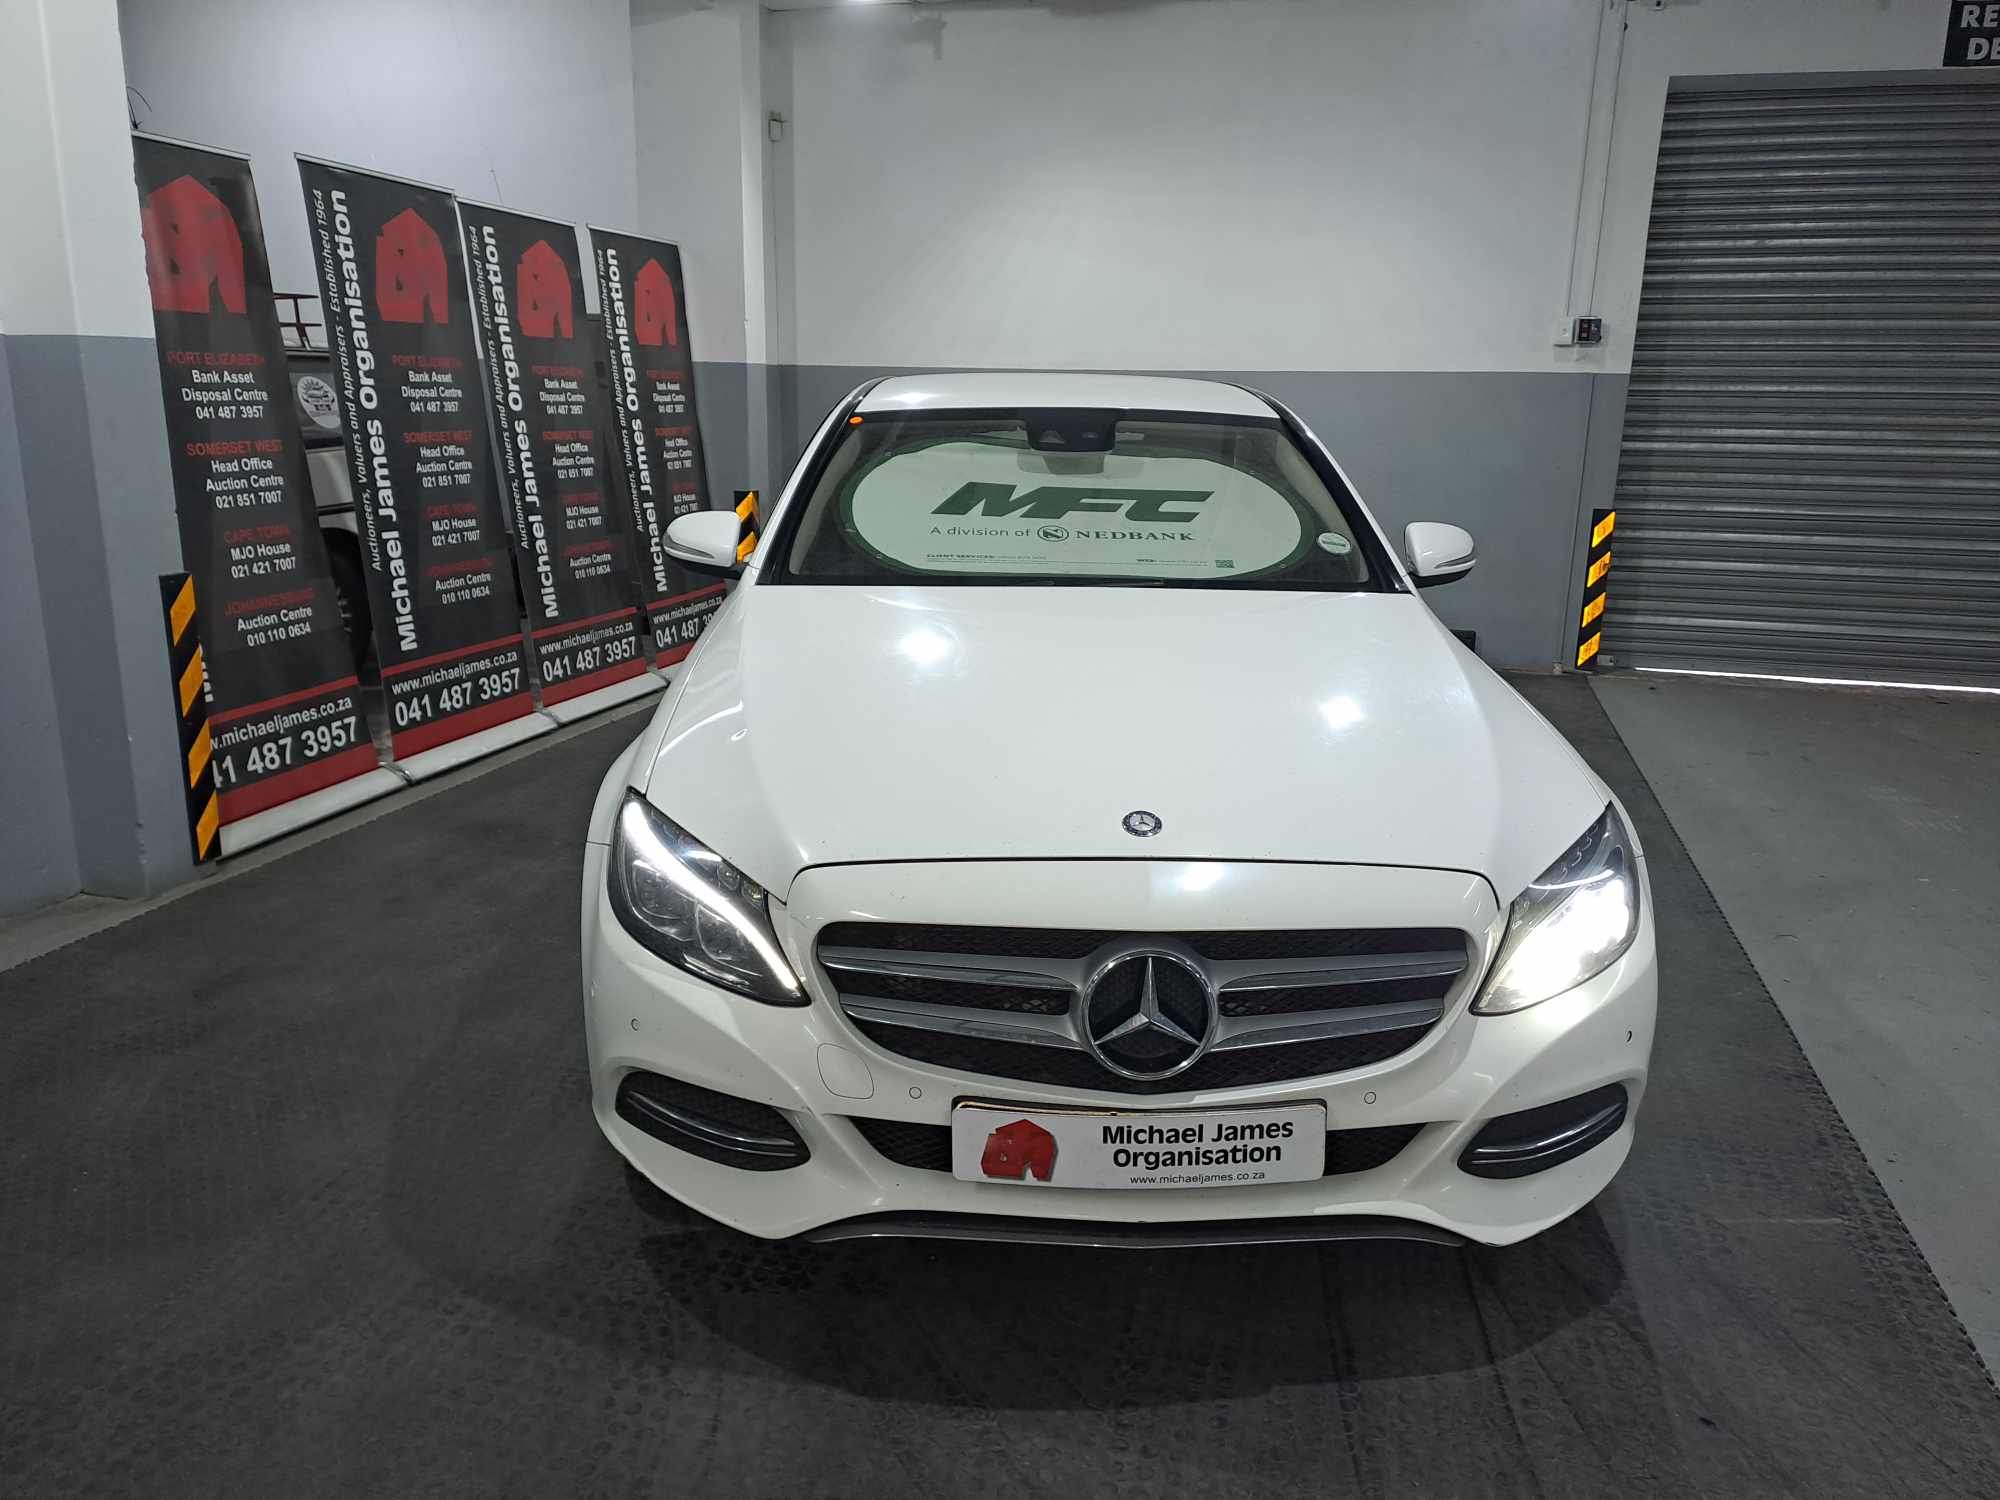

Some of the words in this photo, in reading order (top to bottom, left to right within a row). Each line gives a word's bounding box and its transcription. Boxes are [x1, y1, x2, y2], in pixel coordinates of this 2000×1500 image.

[1960, 5, 2000, 28] RE
[312, 189, 328, 226] 1964
[468, 226, 481, 257] 1964
[317, 229, 342, 313] Established
[330, 190, 379, 410] Organisation
[472, 259, 492, 329] Established
[482, 225, 522, 411] Organisation
[606, 248, 639, 412] Organisation
[335, 325, 355, 399] Appraisers
[487, 340, 504, 403] Appraisers
[192, 369, 221, 383] Bank
[223, 370, 255, 384] Asset
[408, 370, 430, 383] Bank
[431, 371, 453, 383] Asset
[181, 387, 231, 405] Disposal
[234, 388, 268, 401] Centre
[401, 386, 438, 400] Disposal
[439, 387, 463, 399] Centre
[410, 401, 424, 413] 041
[426, 401, 441, 413] 487
[196, 406, 215, 420] 041
[218, 406, 236, 419] 487
[240, 405, 264, 418] 3957
[345, 402, 359, 430] and
[496, 405, 509, 429] and
[616, 405, 626, 426] and
[186, 441, 251, 456] SOMERSET
[352, 432, 368, 483] Valuers
[419, 446, 441, 458] Head
[442, 445, 465, 457] Office
[503, 431, 516, 474] Valuers
[621, 429, 632, 467] Valuers
[632, 419, 652, 495] James
[211, 459, 239, 473] Head
[241, 457, 273, 471] Office
[367, 419, 397, 522] James
[415, 461, 447, 474] Auction
[448, 459, 473, 471] Centre
[515, 420, 540, 507] James
[206, 477, 249, 492] Auction
[250, 474, 284, 488] Centre
[422, 476, 436, 488] 021
[438, 475, 452, 487] 851
[454, 474, 471, 486] 7007
[215, 495, 235, 509] 021
[237, 493, 256, 507] 851
[258, 491, 282, 504] 7007
[511, 479, 529, 549] Auctioneers,
[931, 481, 1215, 523] MFC
[361, 489, 383, 571] Auctioneers,
[432, 520, 450, 532] MJO
[451, 518, 476, 529] House
[432, 535, 446, 546] 021
[447, 532, 461, 544] 421
[463, 530, 480, 542] 7007
[930, 527, 942, 536] A
[947, 527, 1009, 537] division
[1015, 528, 1031, 537] of
[1076, 530, 1196, 541] NEDBANK
[230, 546, 255, 561] MJO
[257, 543, 291, 558] House
[643, 502, 667, 592] Michael
[231, 565, 250, 579] 021
[252, 561, 271, 575] 421
[273, 557, 296, 571] 7007
[528, 515, 559, 618] Michael
[381, 530, 418, 652] Michael
[435, 578, 465, 591] Auction
[466, 572, 491, 585] Centre
[441, 593, 456, 604] 010
[457, 589, 470, 601] 110
[472, 586, 490, 598] 0634
[236, 614, 278, 631] Auction
[280, 606, 313, 622] Centre
[247, 633, 266, 647] 010
[267, 628, 286, 642] 110
[288, 622, 312, 637] 0634
[539, 621, 633, 655] www.michaeljames.co.za
[656, 625, 678, 648] 041
[681, 618, 699, 639] 487
[543, 655, 572, 682] 041
[576, 646, 600, 673] 487
[605, 636, 636, 663] 3957
[391, 651, 518, 696] www.michaeljames.co.za
[395, 694, 432, 727] 041
[439, 682, 472, 712] 487
[478, 667, 520, 700] 3957
[211, 696, 352, 750] w.michaeljames.co.za
[212, 755, 237, 788] 41
[246, 736, 293, 774] 487
[300, 715, 357, 757] 3957
[1102, 1124, 1204, 1145] Michael
[1211, 1121, 1294, 1143] James
[1112, 1144, 1282, 1171] Organisation
[1130, 1171, 1265, 1185] www.michaeljames.co.za
